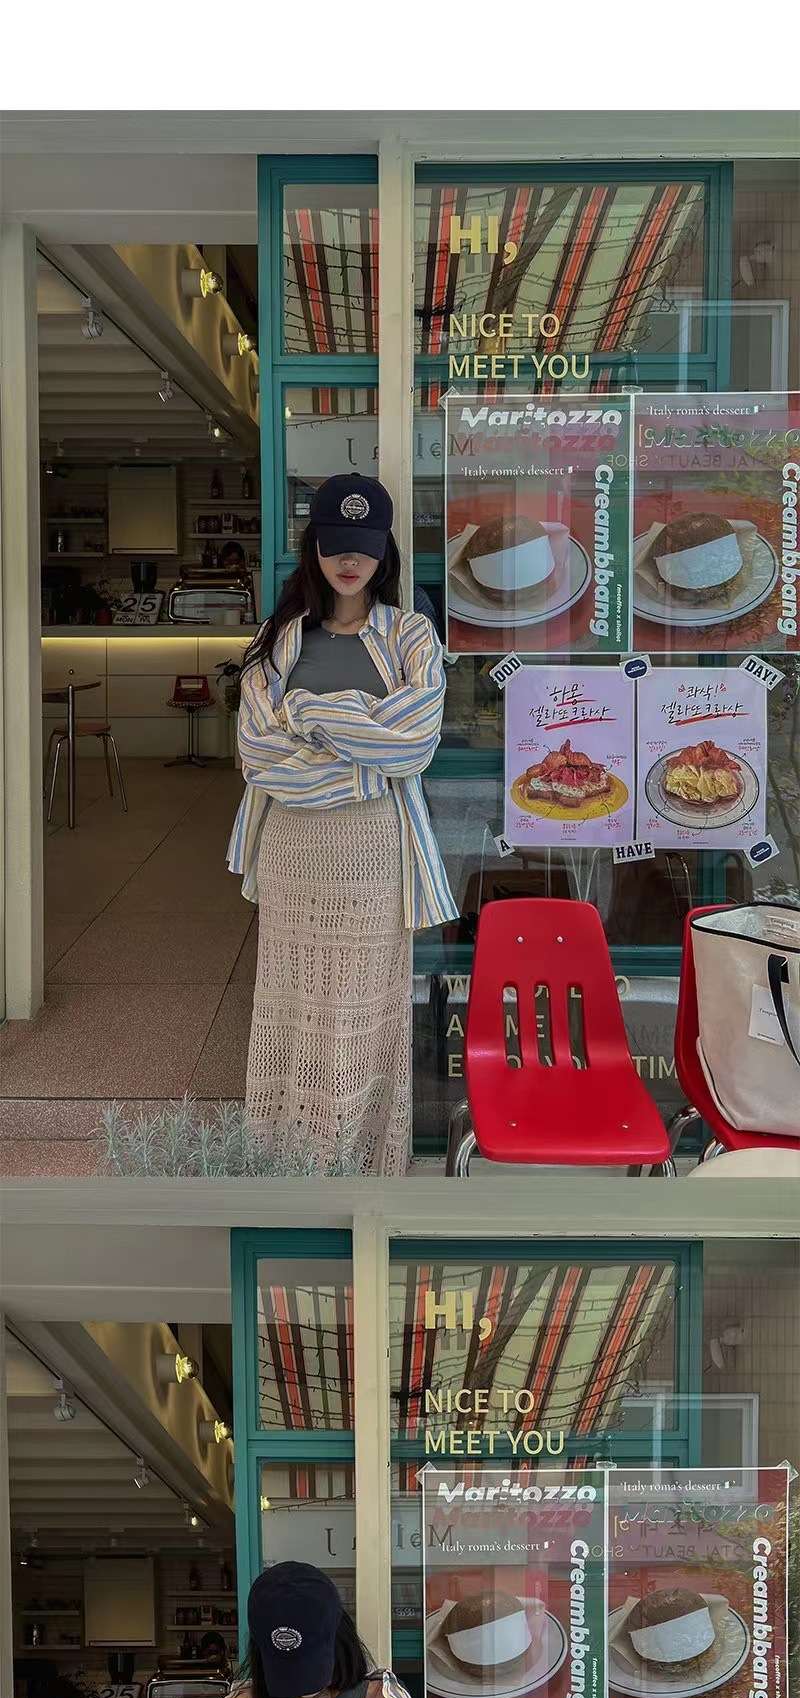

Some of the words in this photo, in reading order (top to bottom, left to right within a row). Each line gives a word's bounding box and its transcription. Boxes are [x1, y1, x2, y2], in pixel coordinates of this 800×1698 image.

[450, 215, 518, 265] HI,
[450, 314, 513, 338] NICE
[522, 314, 560, 338] TO
[449, 354, 524, 379] MEET
[531, 354, 590, 379] YOU
[590, 463, 614, 637] Creambbang
[777, 462, 800, 637] Creambbang
[121, 597, 157, 613] 25
[744, 658, 778, 686] DAY!
[500, 840, 511, 853] A
[615, 841, 654, 858] HAVE
[631, 1055, 678, 1079] TIM
[425, 1290, 492, 1341] HI,
[425, 1389, 489, 1413] NICE
[496, 1389, 535, 1413] TO
[425, 1430, 500, 1455] MEET
[507, 1430, 565, 1455] YOU
